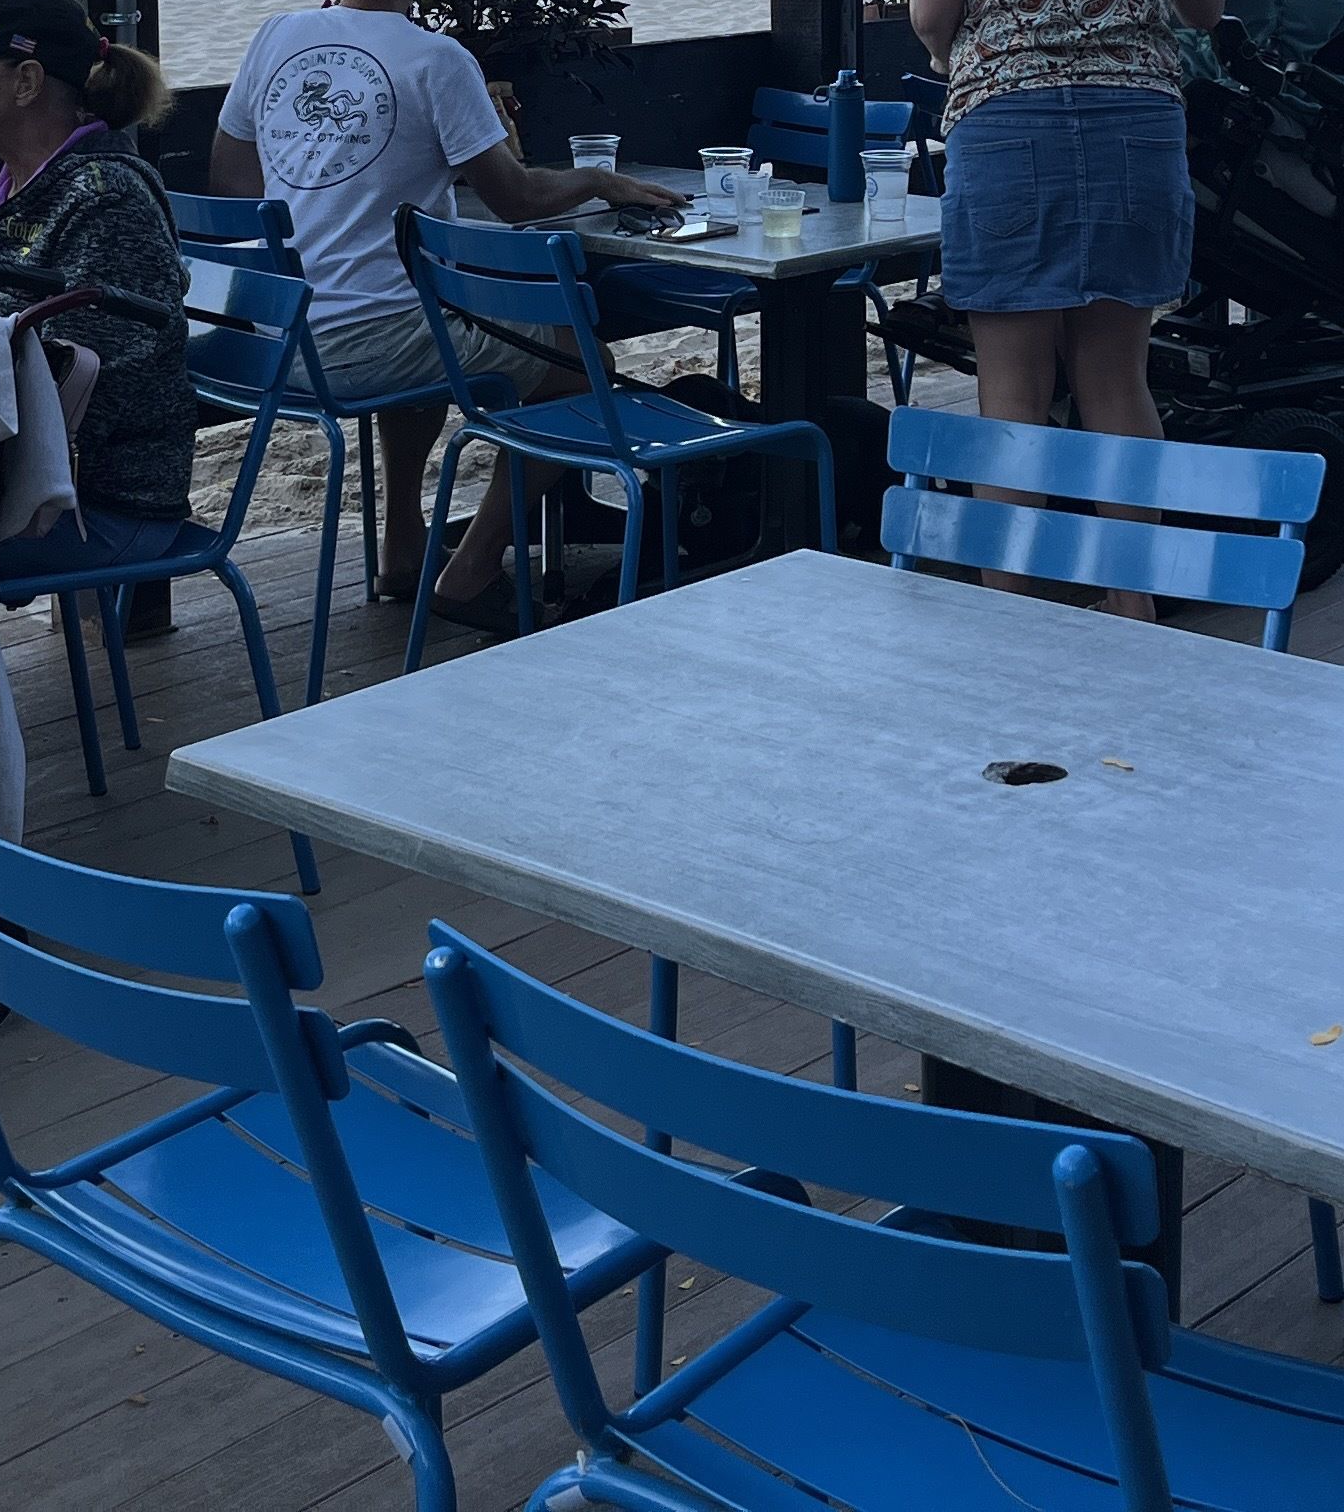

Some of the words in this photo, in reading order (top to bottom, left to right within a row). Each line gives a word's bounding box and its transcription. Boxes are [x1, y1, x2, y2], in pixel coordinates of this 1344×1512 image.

[266, 77, 288, 112] TWO
[289, 52, 347, 78] JOINTS
[351, 56, 382, 86] SURF
[271, 129, 299, 140] SURF
